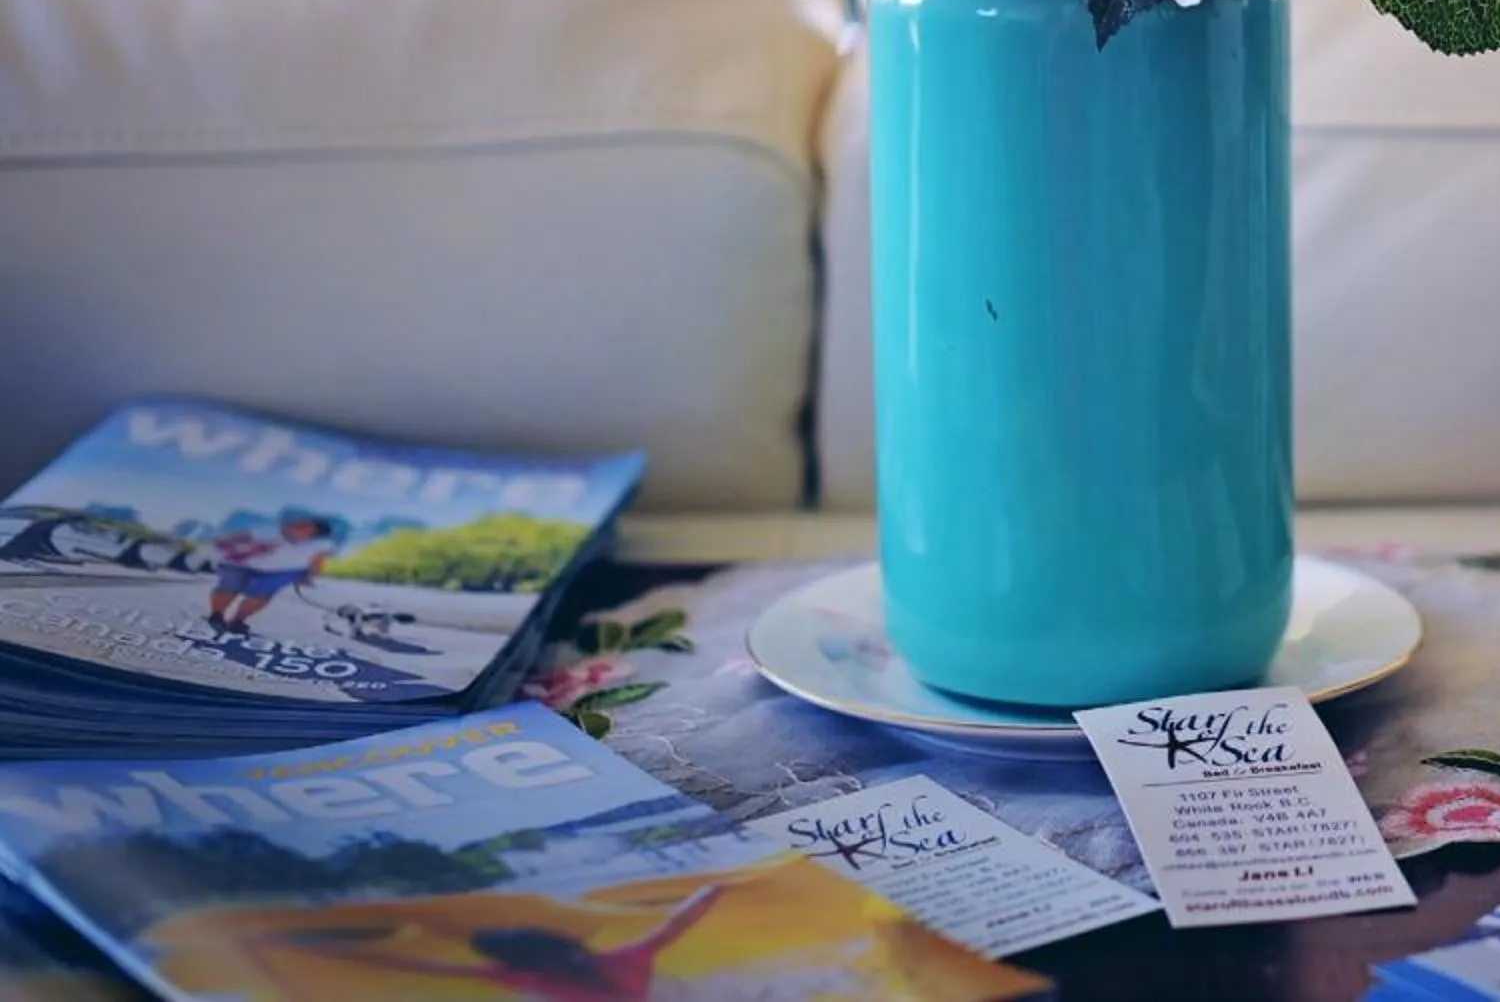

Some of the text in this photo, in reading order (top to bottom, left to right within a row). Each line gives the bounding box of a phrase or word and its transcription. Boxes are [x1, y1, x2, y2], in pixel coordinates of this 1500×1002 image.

[126, 409, 591, 508] where
[254, 654, 358, 678] 150
[1245, 704, 1289, 736] the
[1211, 735, 1296, 767] Sea
[2, 741, 594, 830] where
[1202, 769, 1229, 778] Bed
[1250, 762, 1322, 774] Breakfast
[1248, 785, 1299, 797] Street
[1174, 804, 1224, 816] White
[1229, 800, 1273, 812] Rock
[886, 827, 967, 858] Sea
